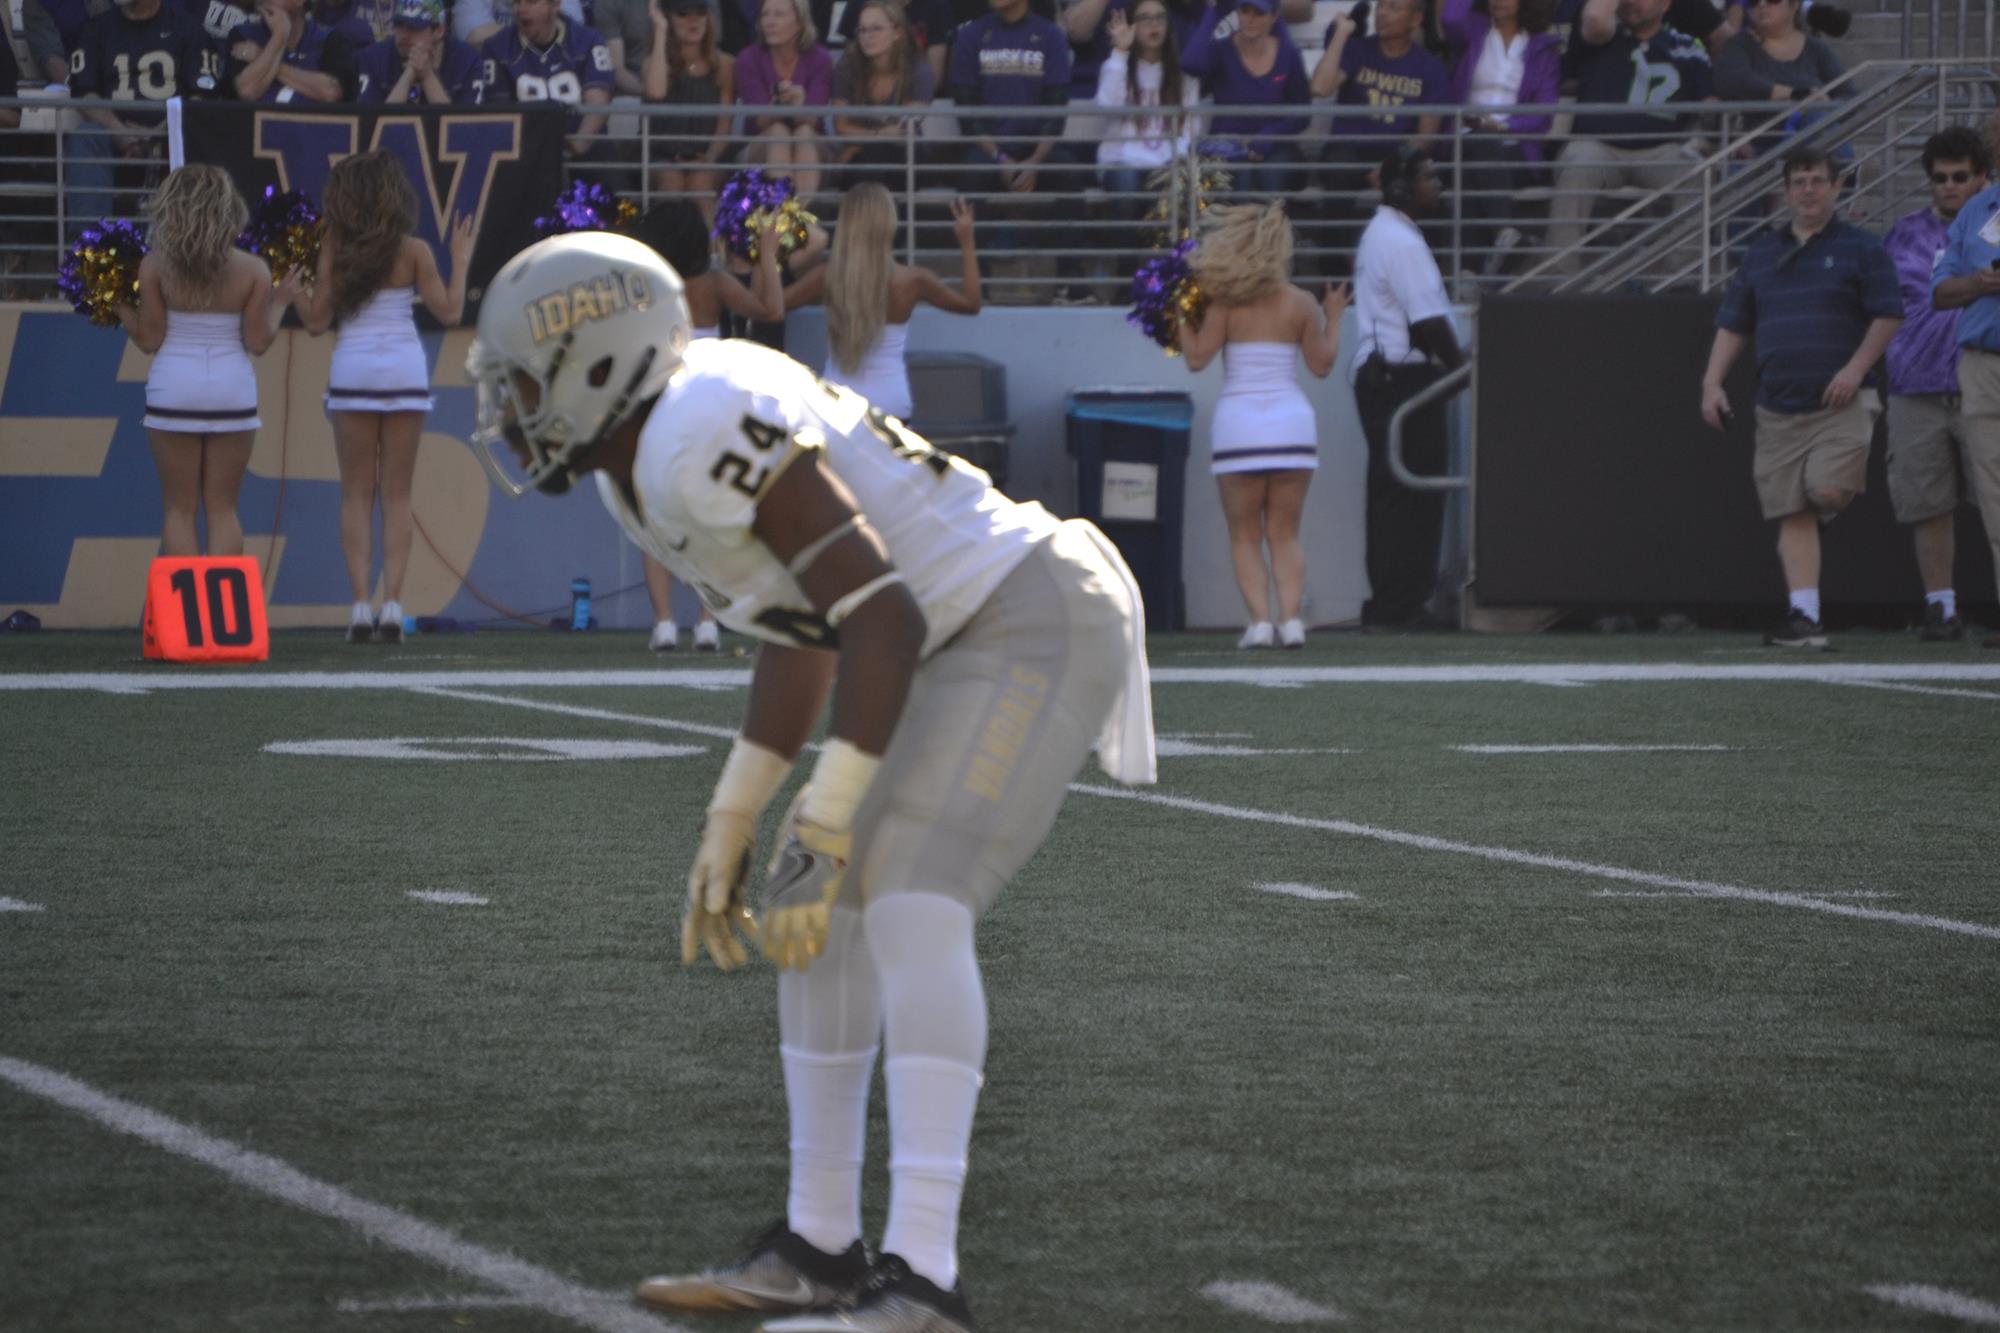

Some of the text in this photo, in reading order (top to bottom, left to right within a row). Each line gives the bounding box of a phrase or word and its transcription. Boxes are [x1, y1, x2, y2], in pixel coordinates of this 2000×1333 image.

[112, 50, 177, 100] 10
[253, 111, 522, 303] W
[524, 269, 655, 345] IDAHO
[709, 412, 788, 499] 24
[170, 567, 253, 648] 10
[960, 665, 1050, 803] VANDALS
